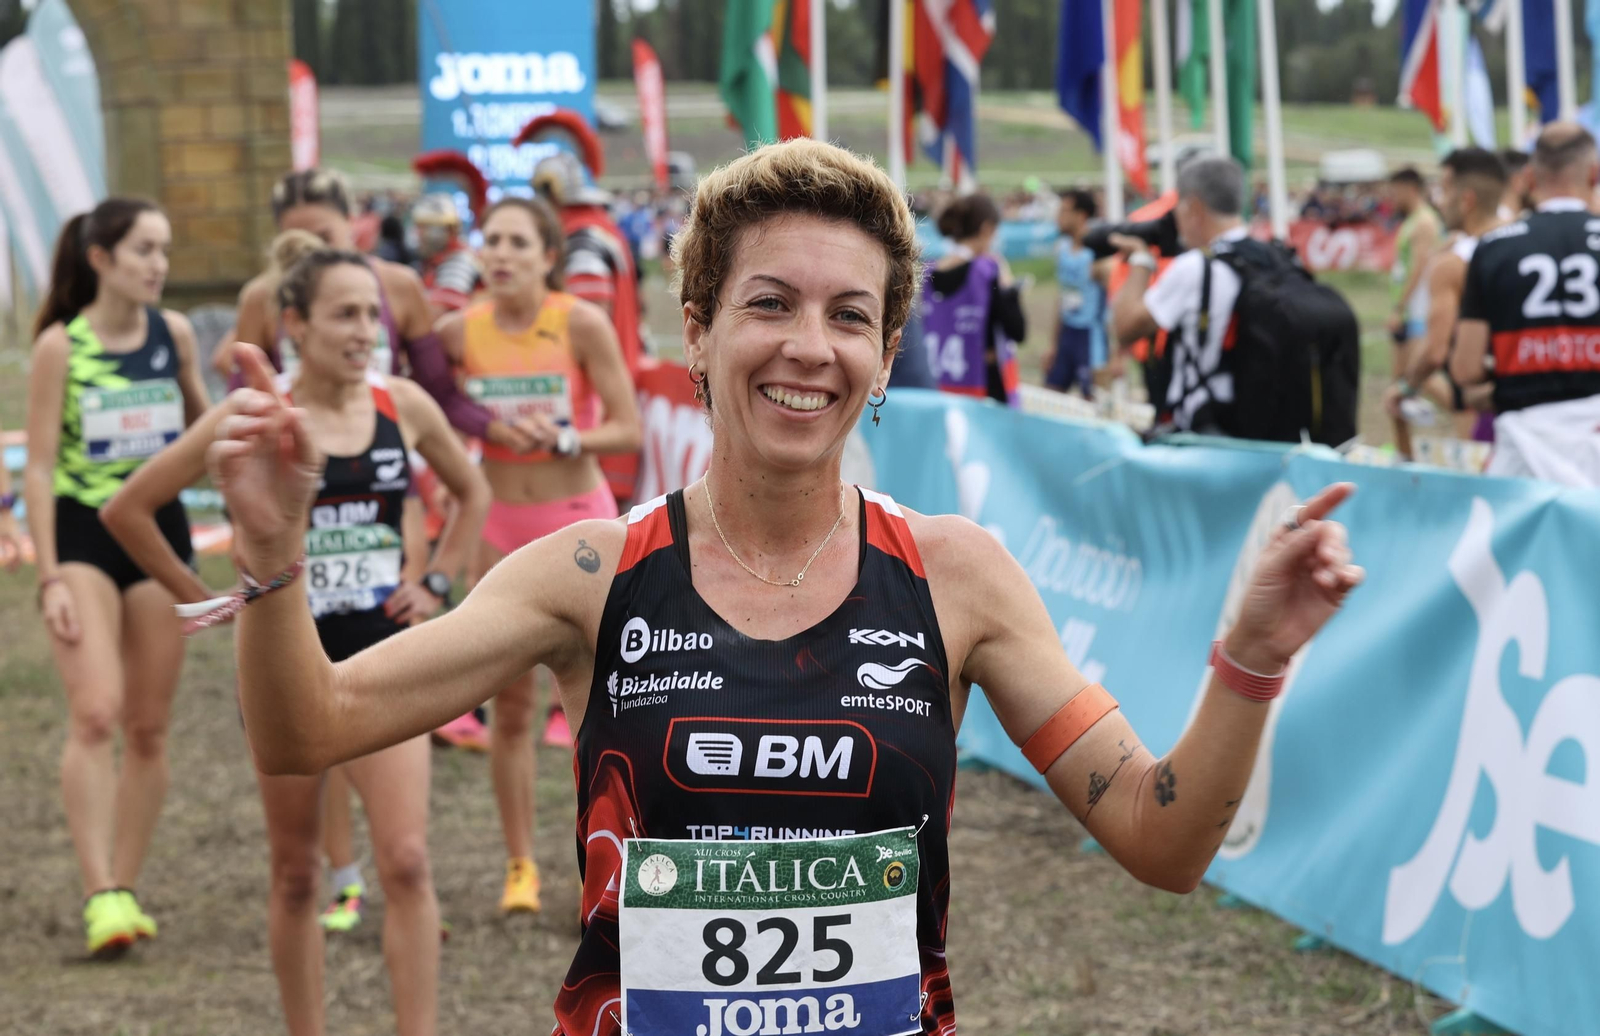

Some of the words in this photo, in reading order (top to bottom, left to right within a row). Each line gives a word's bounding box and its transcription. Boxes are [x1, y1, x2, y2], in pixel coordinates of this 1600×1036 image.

[1517, 253, 1600, 318] 23
[310, 554, 371, 589] 826
[623, 625, 713, 656] Bilbao
[848, 628, 925, 650] KON
[620, 671, 724, 697] Bizkaialde
[620, 694, 668, 711] fundazioa
[840, 693, 932, 717] emteSPORT
[754, 735, 854, 780] BM
[694, 849, 712, 857] XLII
[715, 849, 742, 857] CROSS
[694, 851, 867, 893] ITÁLICA
[694, 895, 780, 903] INTERNATIONAL
[784, 894, 816, 902] CROSS
[820, 889, 867, 900] COUNTRY
[702, 914, 853, 986] 825
